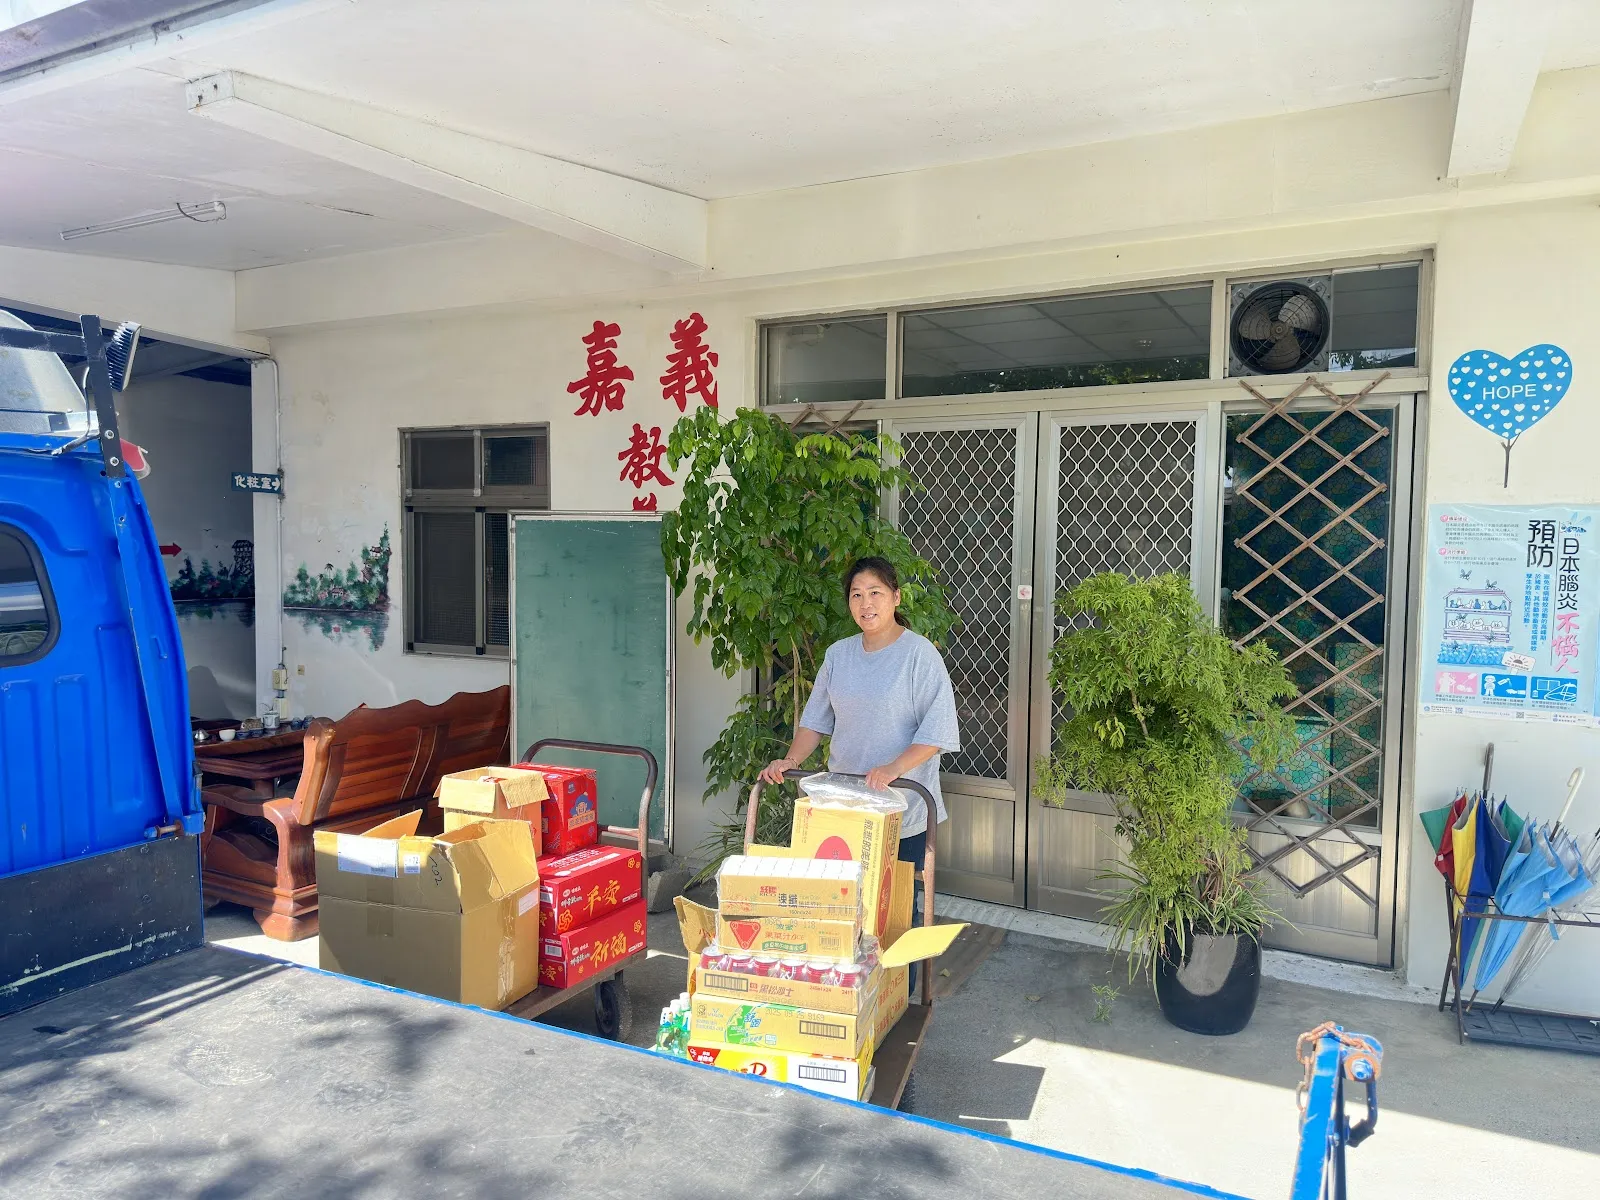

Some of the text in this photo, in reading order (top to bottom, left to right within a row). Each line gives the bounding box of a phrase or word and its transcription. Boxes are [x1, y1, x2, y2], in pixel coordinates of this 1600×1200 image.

[567, 312, 719, 417] 嘉義
[1482, 383, 1537, 400] HOPE
[234, 474, 273, 490] 化粧室
[1526, 519, 1556, 568] 預防
[583, 879, 622, 917] 平安
[590, 930, 627, 969] 祈福
